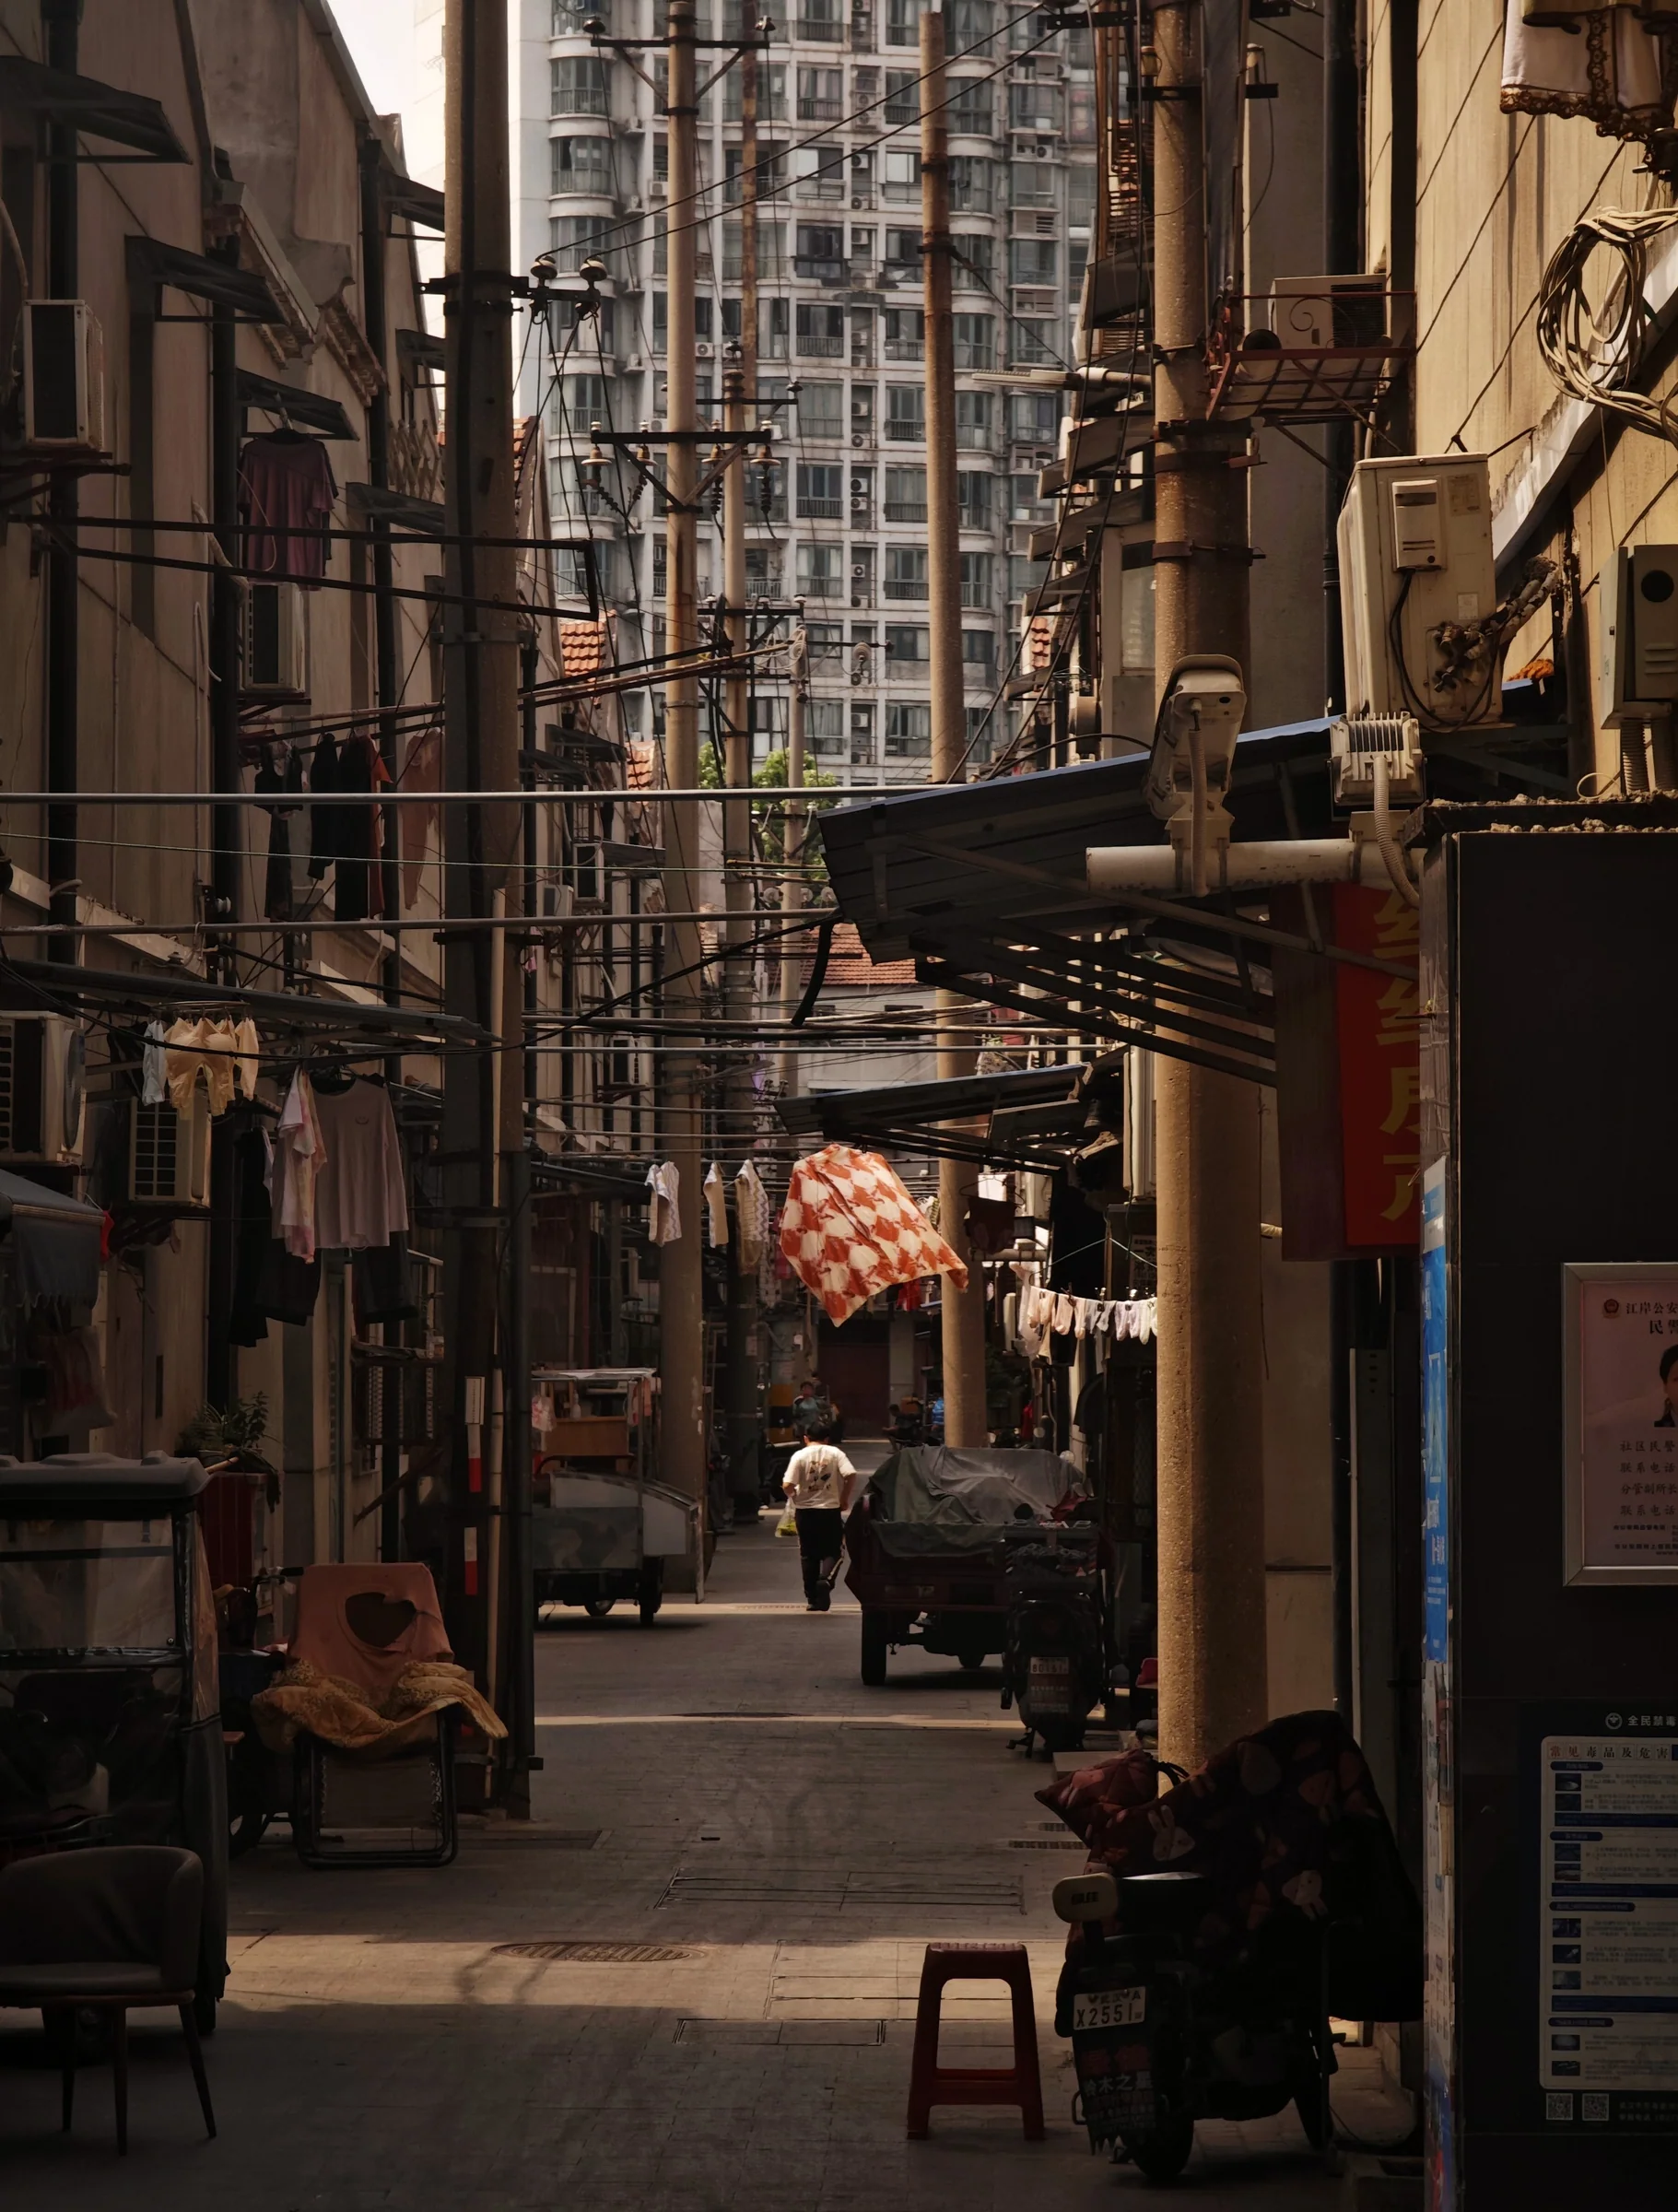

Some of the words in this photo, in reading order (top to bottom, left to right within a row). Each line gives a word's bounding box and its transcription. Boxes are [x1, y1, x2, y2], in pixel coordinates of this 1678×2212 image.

[1619, 1440, 1676, 1453] 社区民警
[1619, 1462, 1676, 1474] 联系电话
[1619, 1504, 1676, 1516] 联系电话
[1627, 1714, 1677, 1727] 全民禁毒
[1550, 1745, 1669, 1759] 常见毒品及危害
[1132, 1990, 1141, 2001] A
[1076, 2003, 1132, 2028] X2551
